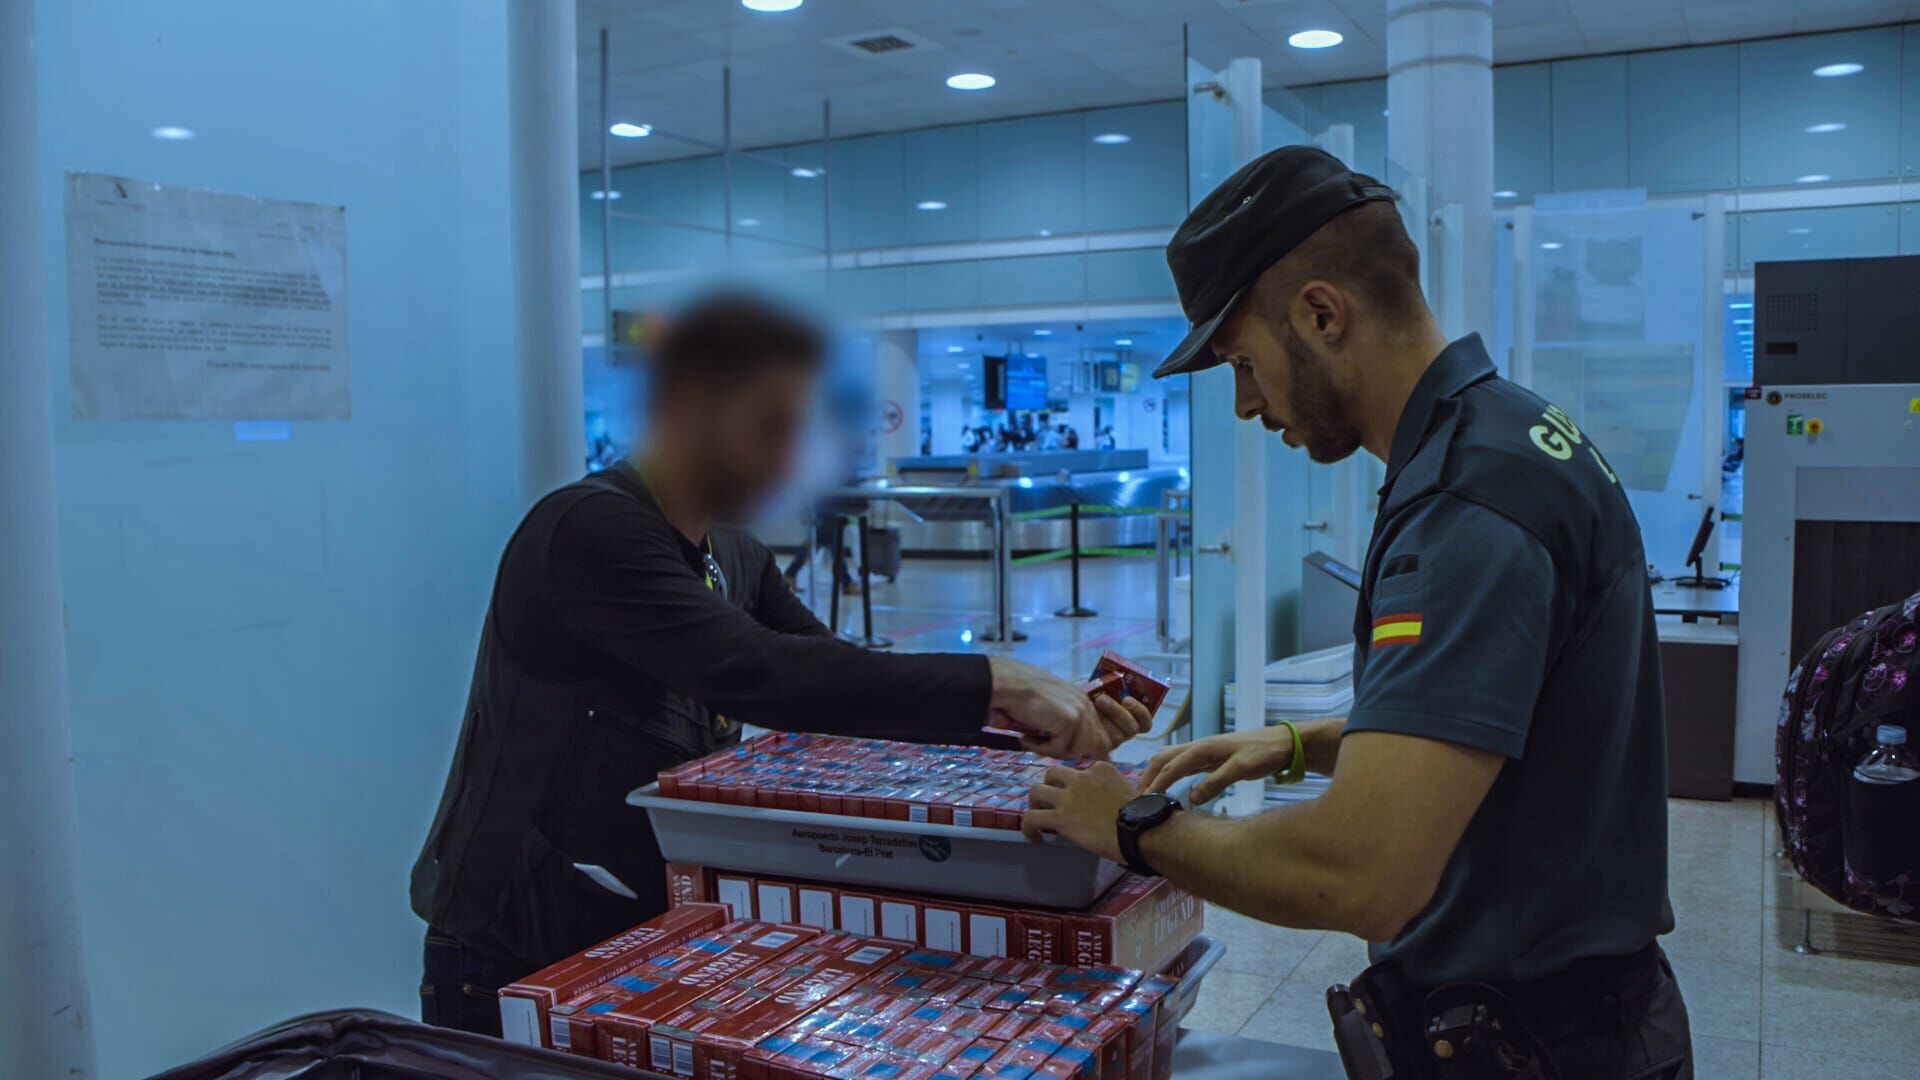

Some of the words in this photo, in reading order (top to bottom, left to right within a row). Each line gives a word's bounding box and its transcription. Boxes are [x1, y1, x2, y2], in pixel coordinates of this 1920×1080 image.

[792, 827, 840, 842] Aeropuerto
[841, 831, 869, 846] Josep
[584, 927, 656, 958] LEGEND
[678, 951, 749, 985] LEGEND
[774, 967, 844, 1004] LEGEND
